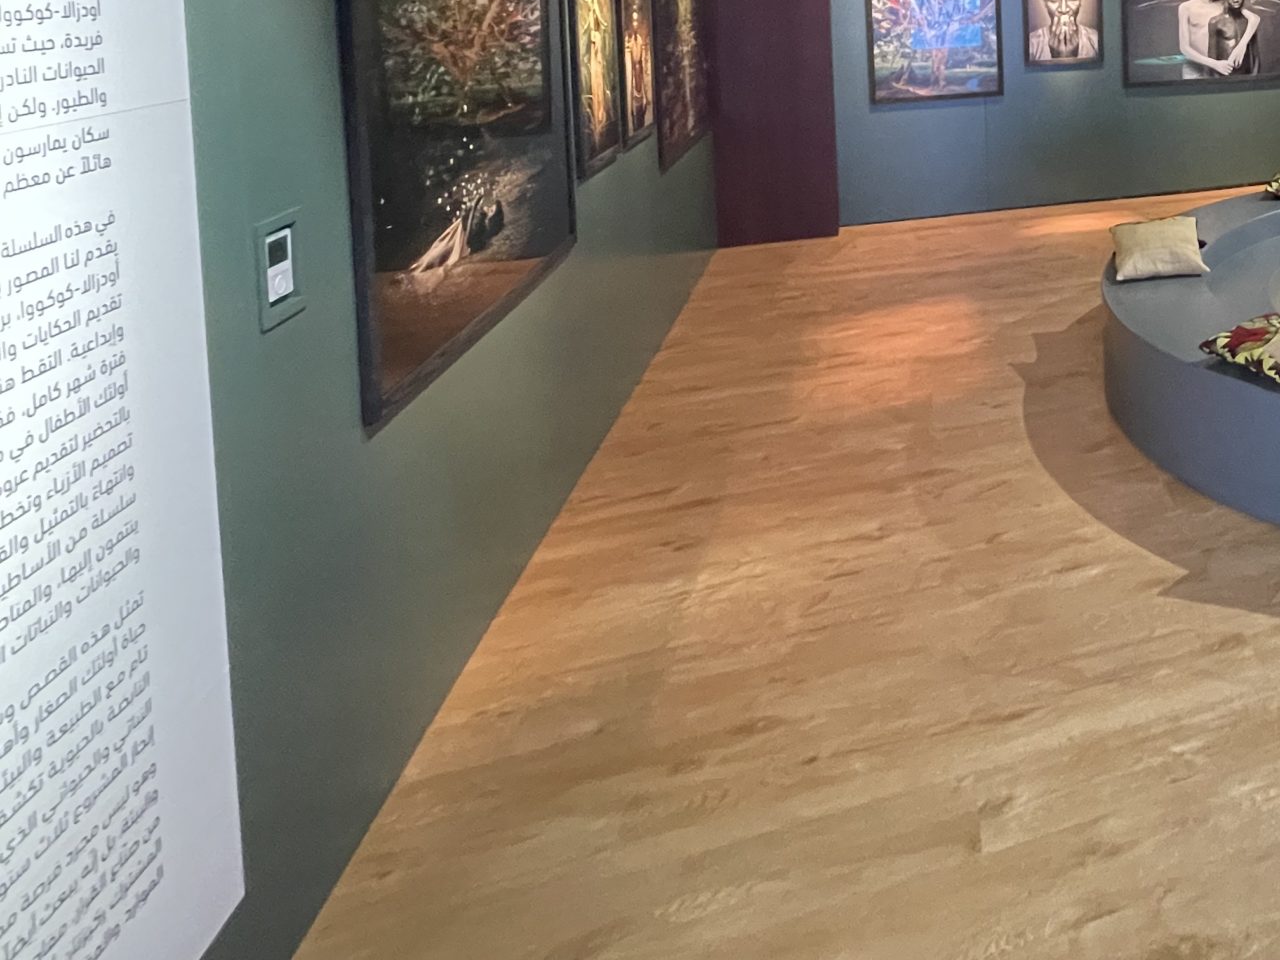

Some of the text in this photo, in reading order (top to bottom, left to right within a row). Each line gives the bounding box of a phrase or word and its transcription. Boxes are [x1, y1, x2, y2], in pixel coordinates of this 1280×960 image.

[22, 34, 55, 55] حيث
[42, 57, 105, 82] الحيوانات
[8, 96, 47, 123] ولكن
[3, 126, 110, 166] سكان يمارسون
[3, 172, 51, 200] معظم
[55, 166, 76, 185] عن
[1, 209, 116, 258] في هذه السلسلة
[7, 239, 119, 296] يقدم لنا المصور
[22, 309, 81, 350] الحكايات
[85, 292, 122, 327] تقديم
[21, 348, 62, 384] التقط
[66, 363, 96, 399] شهر
[99, 350, 126, 376] فترة
[9, 369, 128, 463] أولئك الأطفال في
[82, 406, 131, 452] بالتحضير
[33, 434, 79, 481] لتقديم
[90, 432, 133, 478] تصميم
[46, 459, 87, 501] الأزياء
[33, 492, 89, 544] بالتمثيل
[91, 492, 137, 530] سلسلة
[65, 527, 88, 554] من
[95, 519, 139, 562] ينتمون
[10, 547, 141, 656] والحيوانات والنباتات
[114, 589, 144, 630] تمثل
[81, 623, 111, 654] هذه
[121, 623, 146, 650] حياة
[20, 644, 78, 711] القصص
[81, 634, 118, 686] أولئك
[34, 675, 78, 734] الصغار
[105, 670, 126, 700] مع
[46, 685, 103, 748] الطبيعة
[48, 720, 104, 780] بالحيوية
[101, 783, 131, 831] ليس
